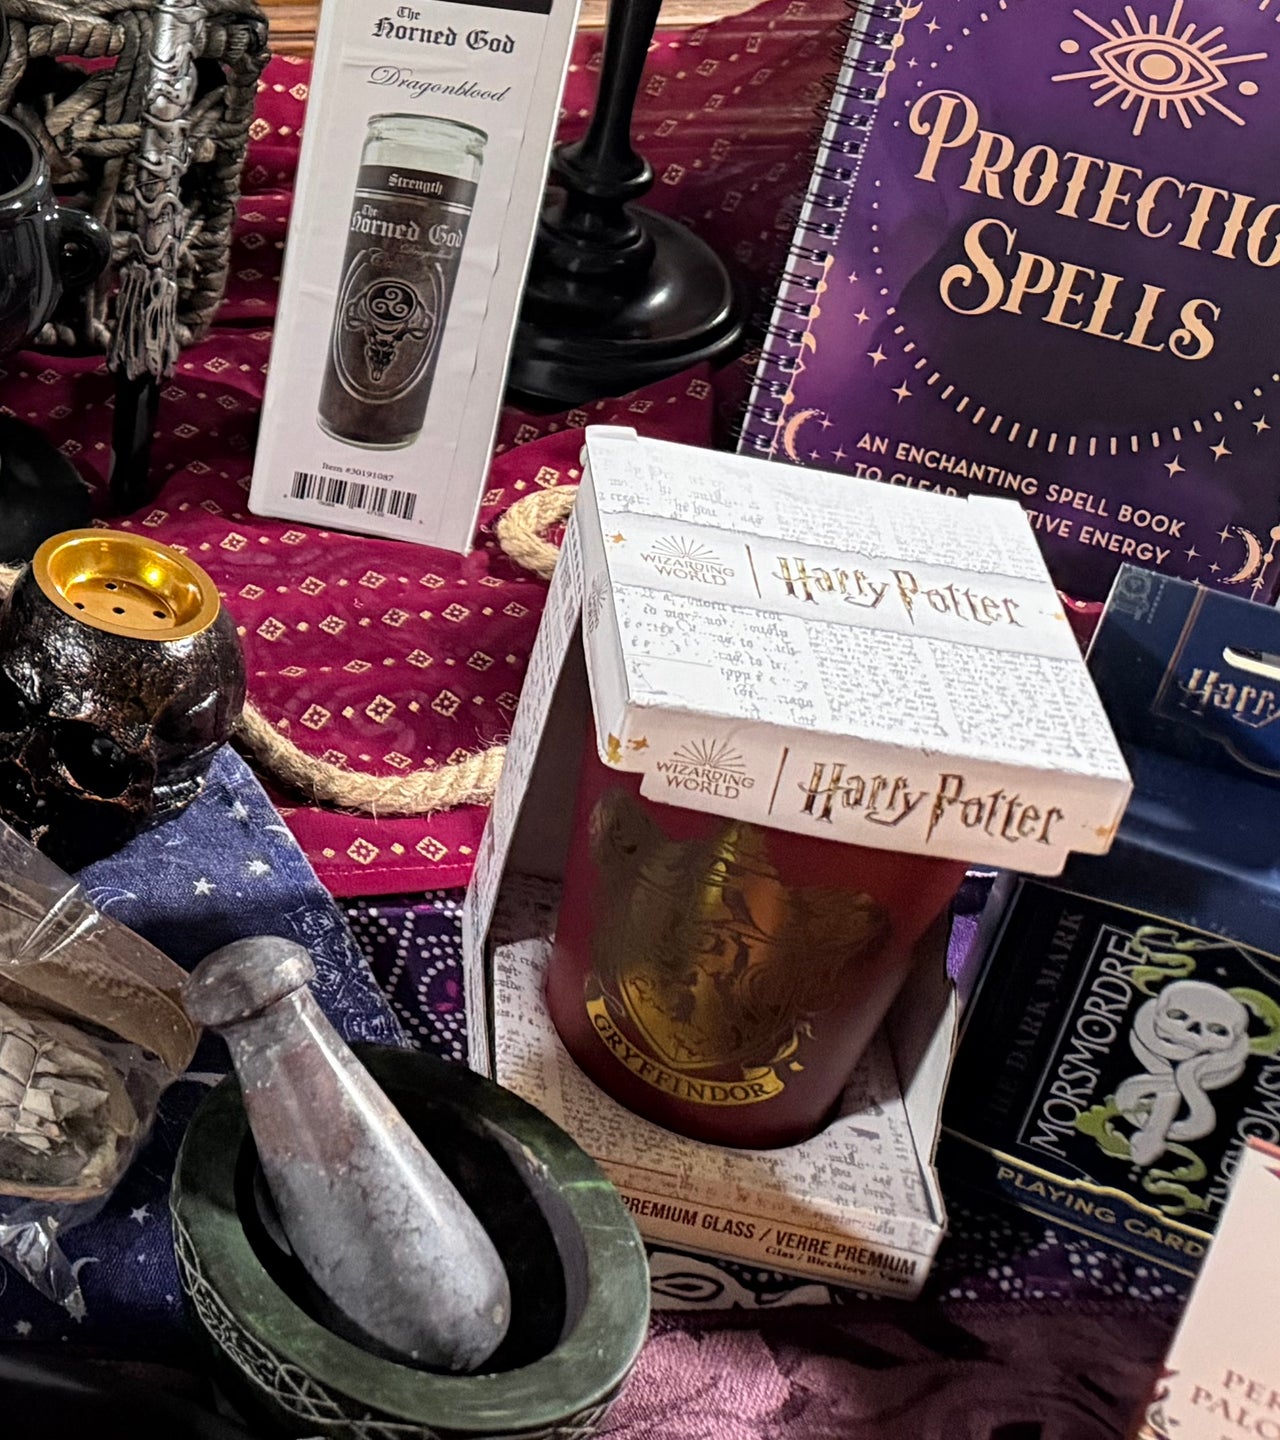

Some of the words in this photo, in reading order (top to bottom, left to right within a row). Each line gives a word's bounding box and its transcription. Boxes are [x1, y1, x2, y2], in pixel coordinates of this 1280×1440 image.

[372, 16, 458, 47] Horned
[465, 27, 516, 55] God
[396, 5, 421, 21] The
[366, 64, 512, 103] Dragonblood
[387, 172, 444, 197] Strength
[909, 88, 1280, 268] PROTECTIO
[350, 213, 420, 242] Horned
[428, 223, 465, 248] God
[360, 203, 379, 218] The
[939, 217, 1223, 362] SPELLS
[856, 432, 889, 455] AN
[895, 440, 1040, 497] ENCHANTING
[1046, 481, 1112, 519] SPELL
[1118, 499, 1186, 540] BOOK
[854, 462, 886, 485] TO
[1076, 518, 1173, 566] ENERGY
[640, 552, 735, 578] WIZARDING
[654, 564, 727, 587] WORLD
[771, 555, 889, 610] Harry
[888, 566, 1022, 627] Potter
[656, 761, 755, 789] WIZARDING
[666, 775, 741, 800] WORLD
[797, 761, 927, 826] Harry
[926, 771, 1065, 845] Potter
[594, 1013, 774, 1102] GRYFFINDOR
[1030, 935, 1149, 1158] MORSMORDRE
[998, 1166, 1118, 1224] PLAYING
[621, 1193, 699, 1227] PREMIUM
[701, 1212, 757, 1240] GLASS
[775, 1229, 829, 1257] VERRE
[834, 1244, 918, 1276] PREMIUM
